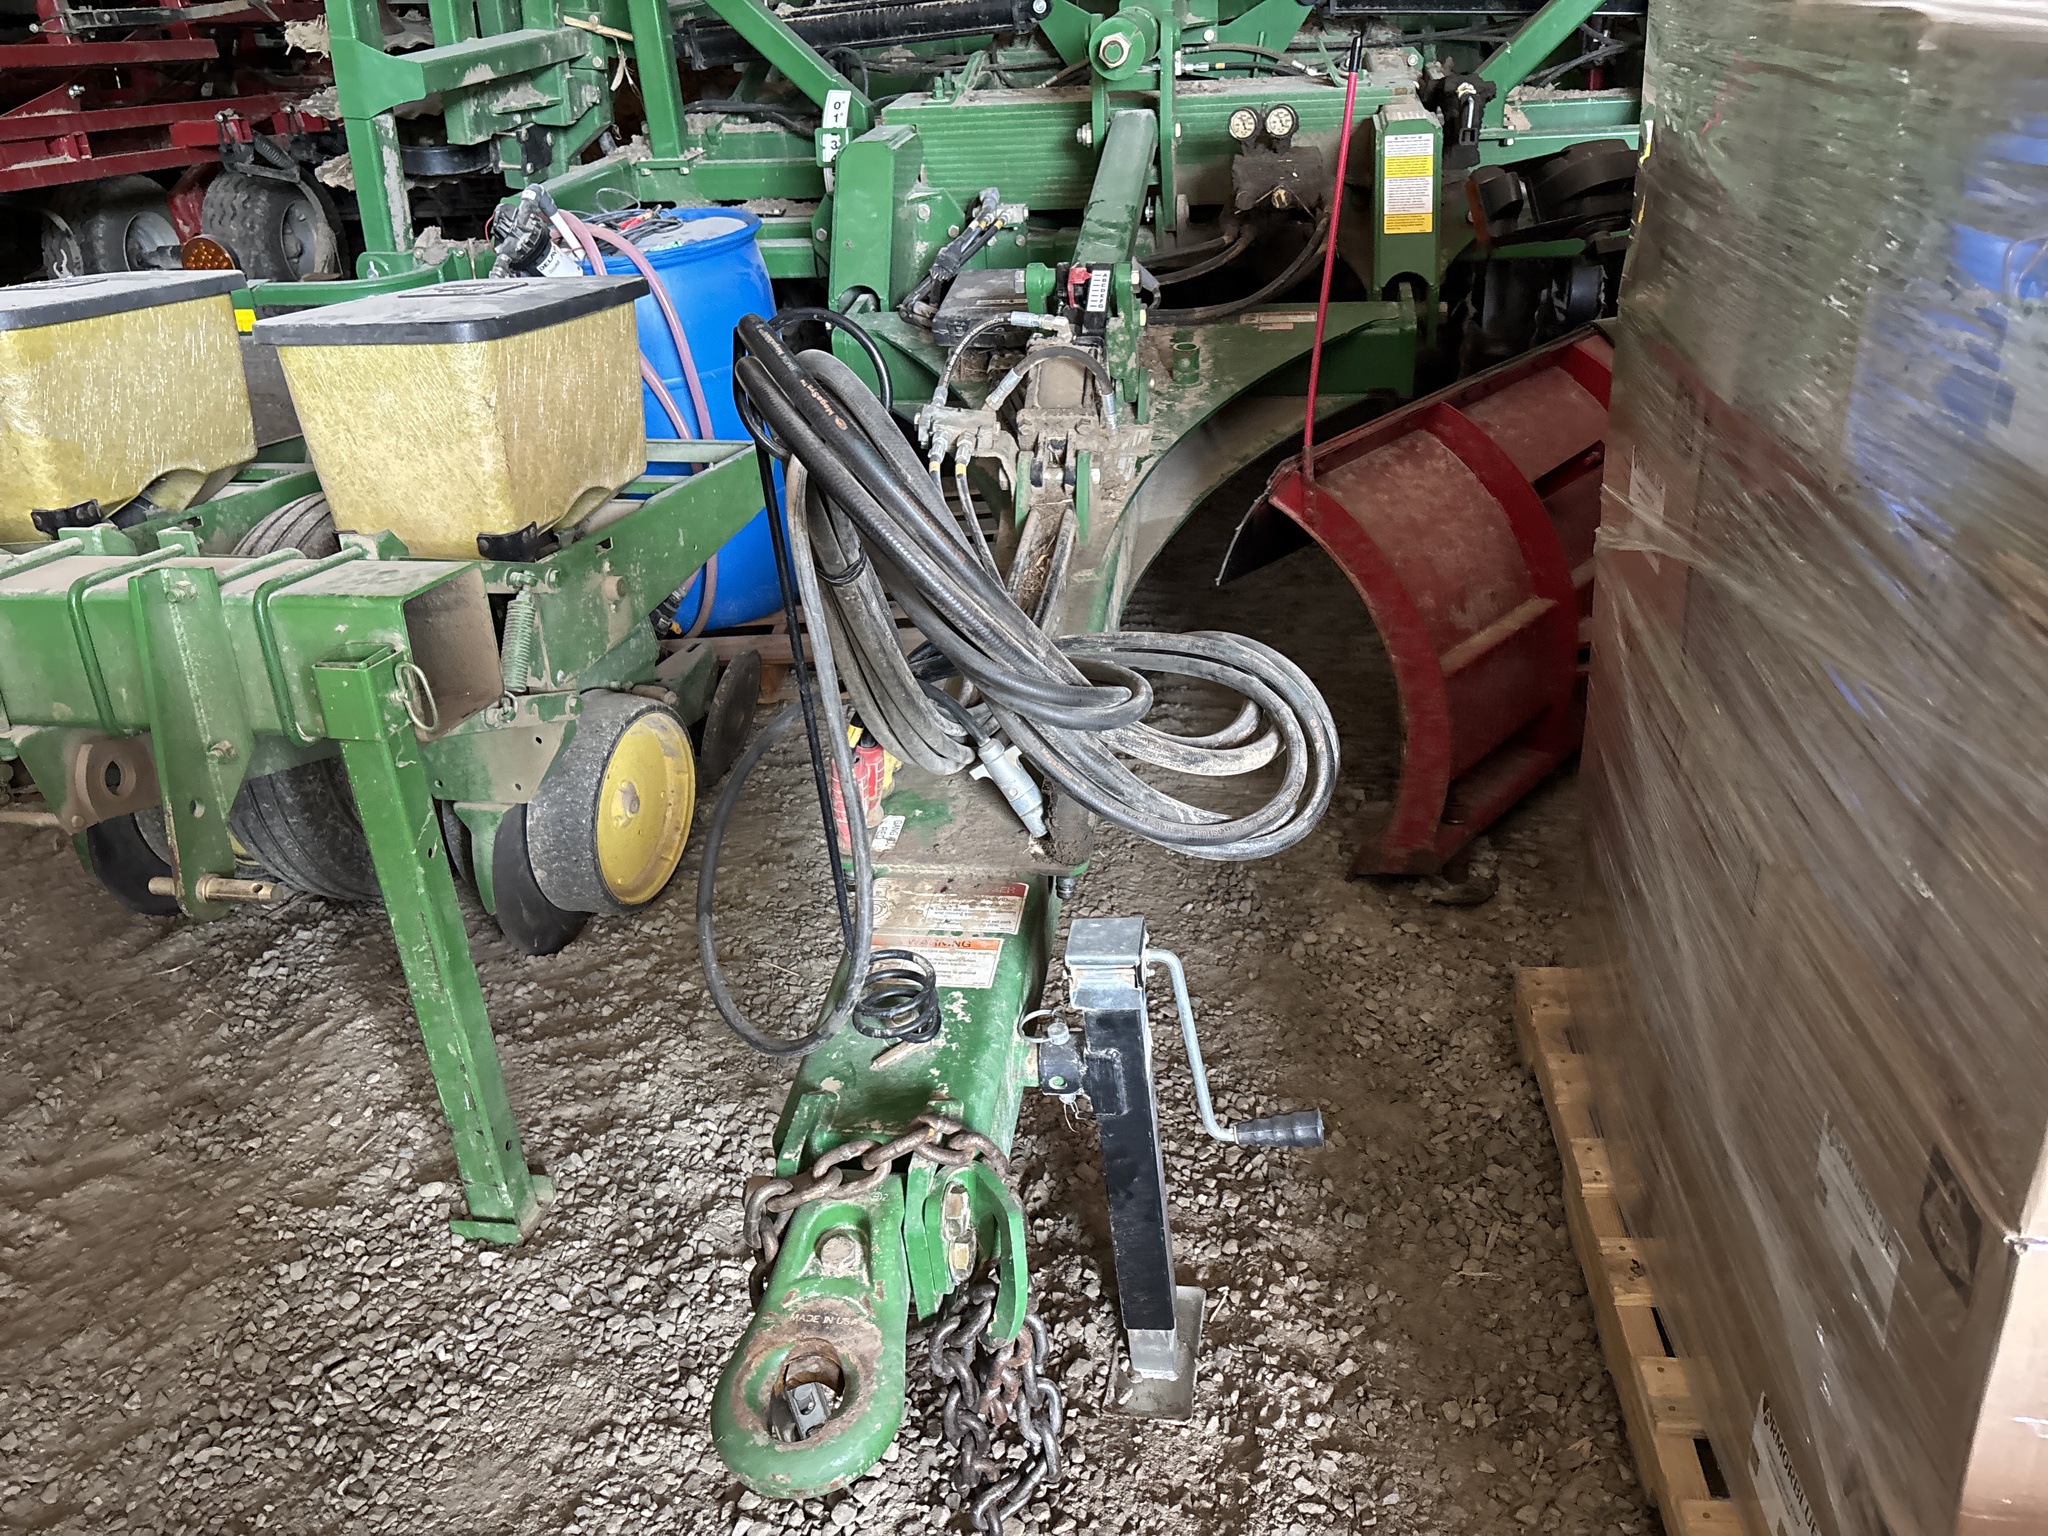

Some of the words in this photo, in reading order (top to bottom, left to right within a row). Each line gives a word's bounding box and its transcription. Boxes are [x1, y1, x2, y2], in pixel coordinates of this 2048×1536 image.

[890, 820, 902, 836] GANG
[908, 938, 972, 948] WANNG
[791, 1314, 820, 1324] MADE
[822, 1316, 834, 1324] IN
[836, 1318, 858, 1326] USA
